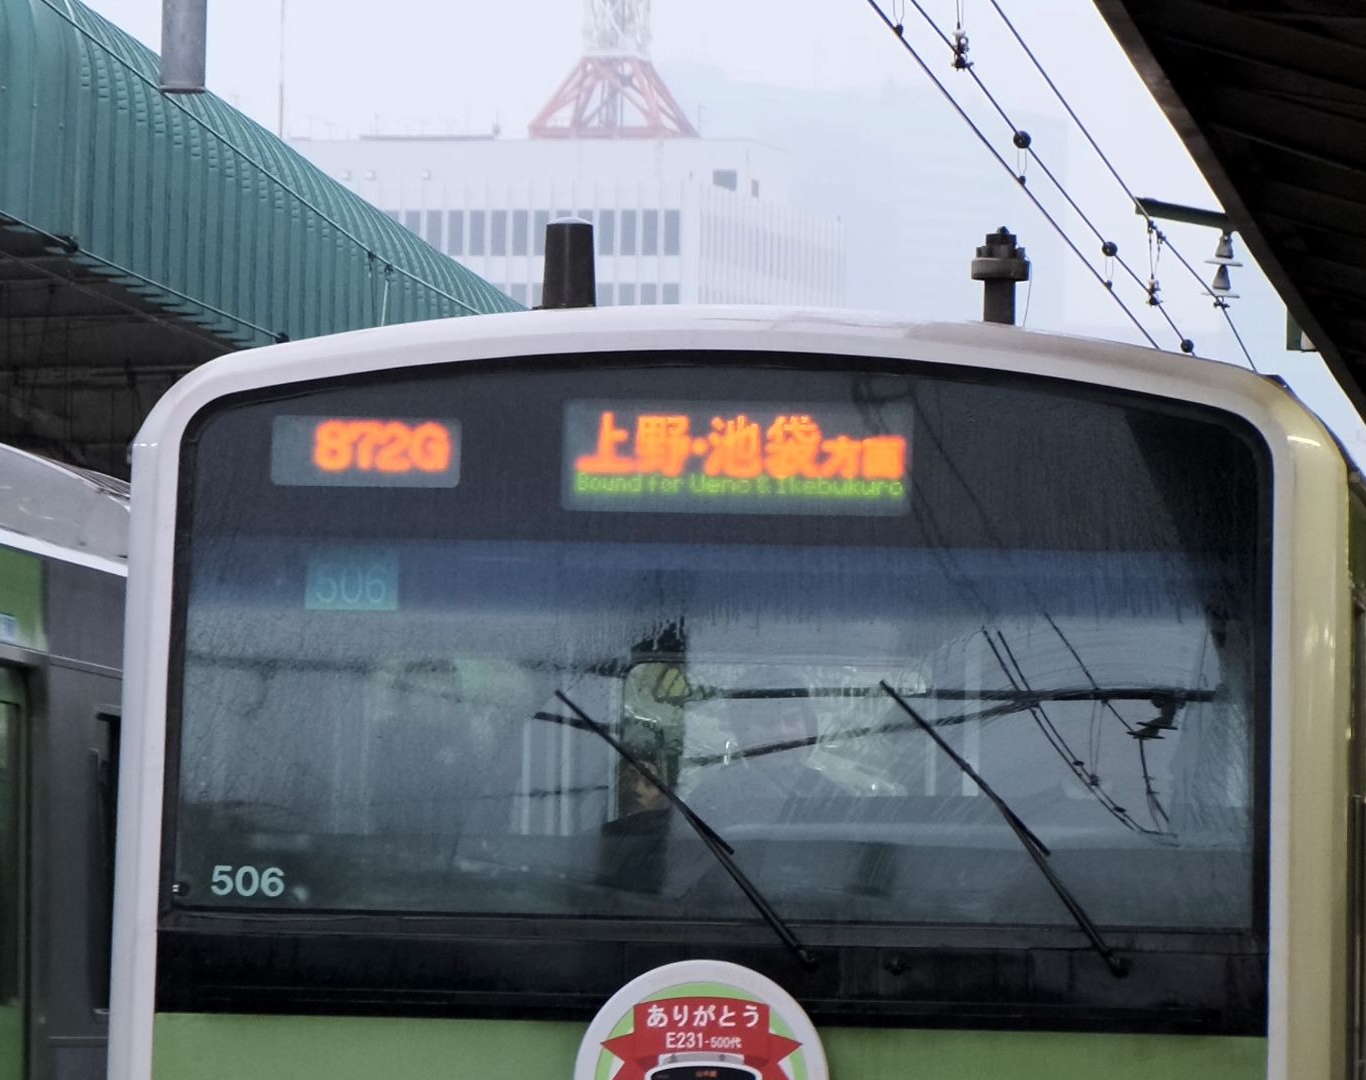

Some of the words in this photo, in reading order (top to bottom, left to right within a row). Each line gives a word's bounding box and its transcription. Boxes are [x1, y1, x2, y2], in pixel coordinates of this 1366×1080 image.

[314, 419, 452, 471] 872G
[576, 412, 904, 479] 上野・池袋方面
[316, 562, 387, 604] 506
[211, 865, 285, 897] 506
[646, 1004, 759, 1027] ありがとう
